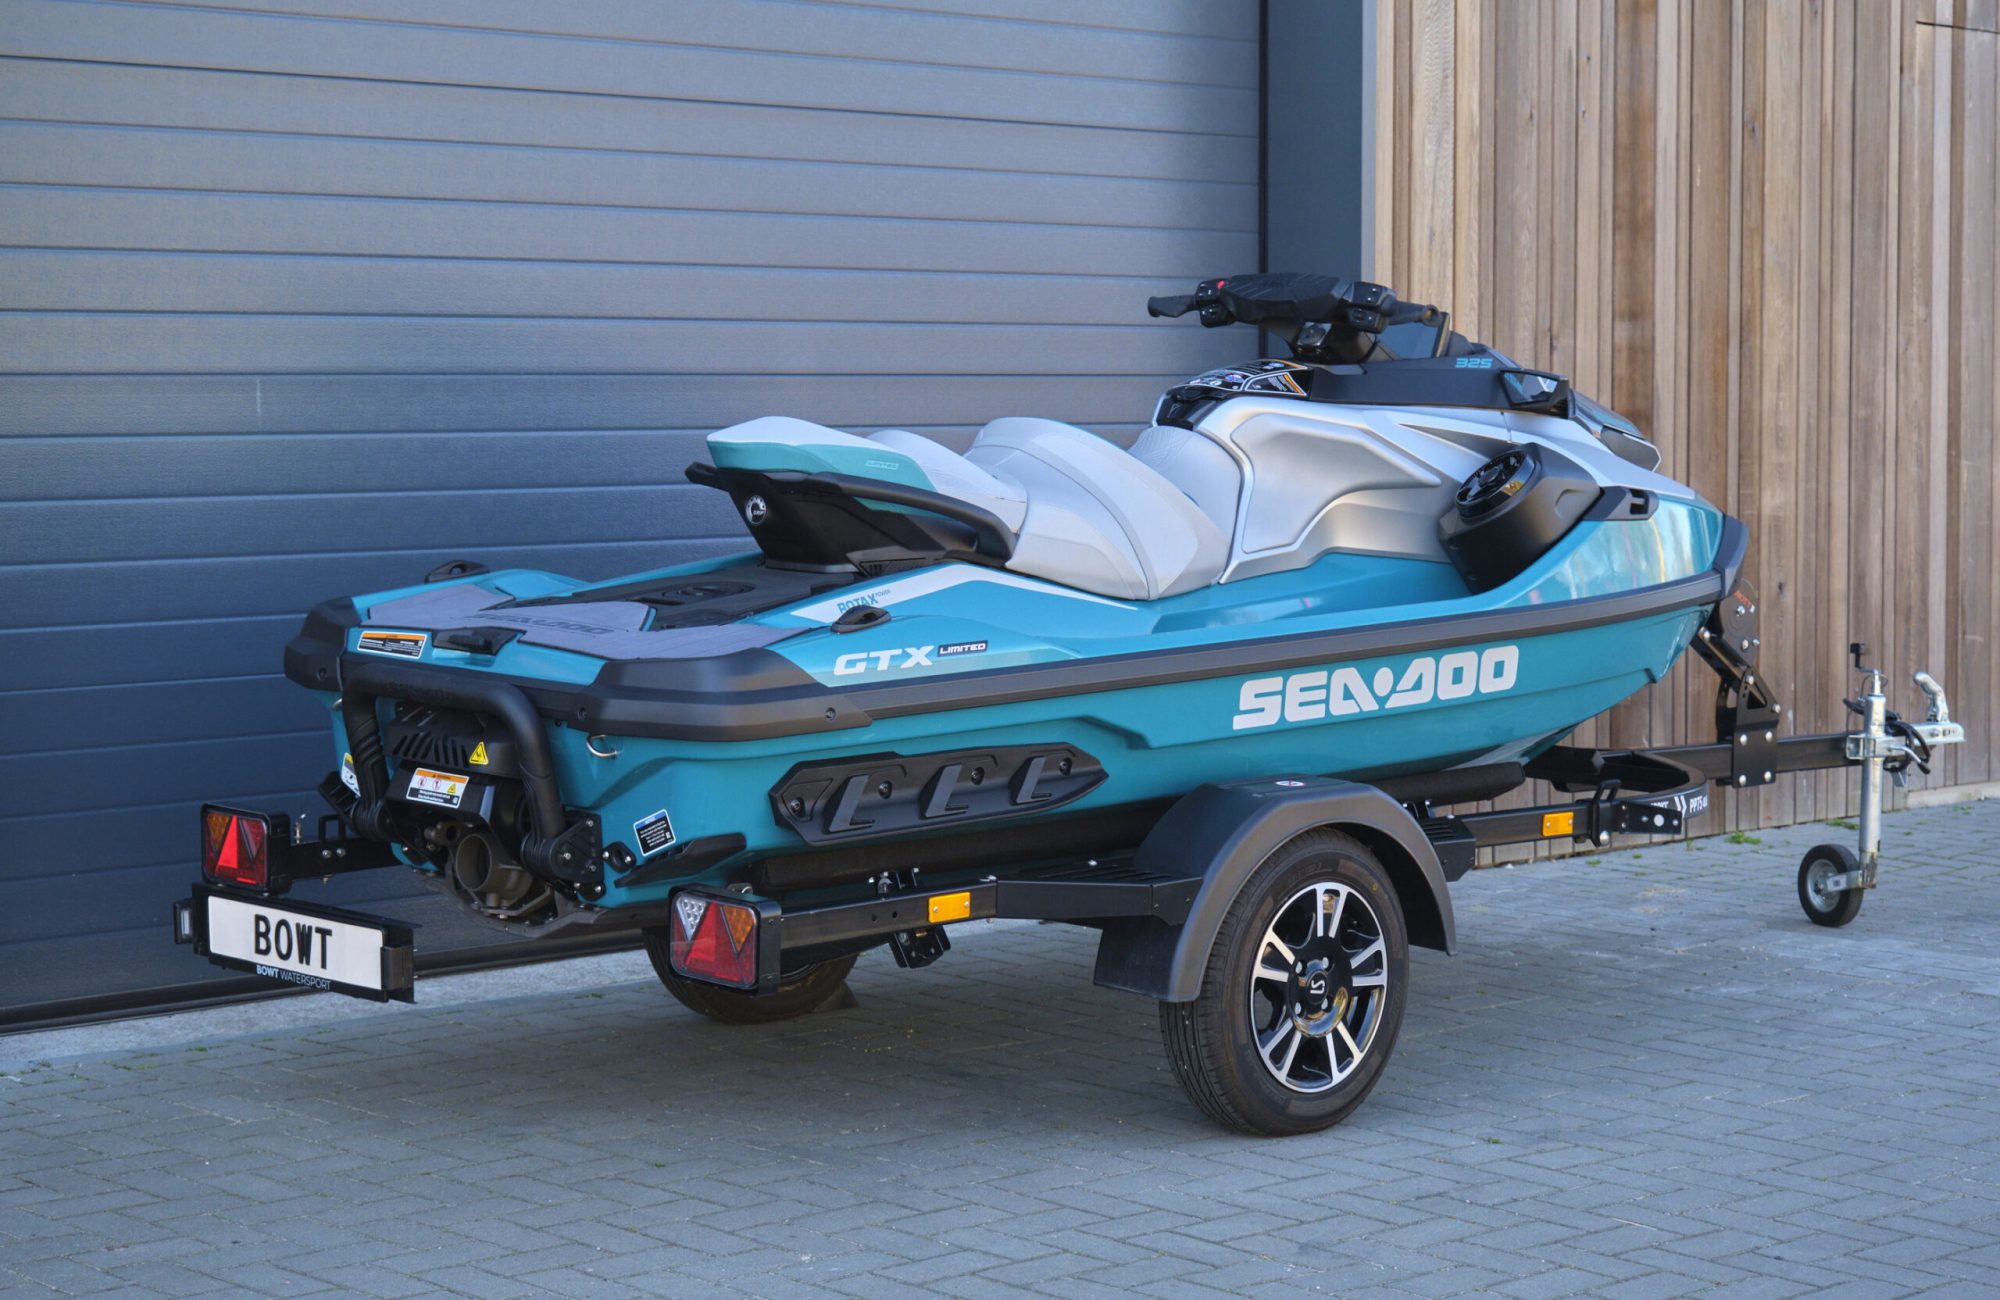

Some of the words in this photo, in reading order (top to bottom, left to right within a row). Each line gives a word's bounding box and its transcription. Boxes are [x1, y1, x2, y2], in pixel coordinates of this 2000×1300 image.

[1455, 357, 1493, 369] 325
[833, 645, 935, 676] GTX
[939, 642, 986, 655] LIMITED
[254, 913, 333, 970] BOWT
[256, 964, 279, 978] BOWT
[279, 969, 332, 990] WATERSPORT
